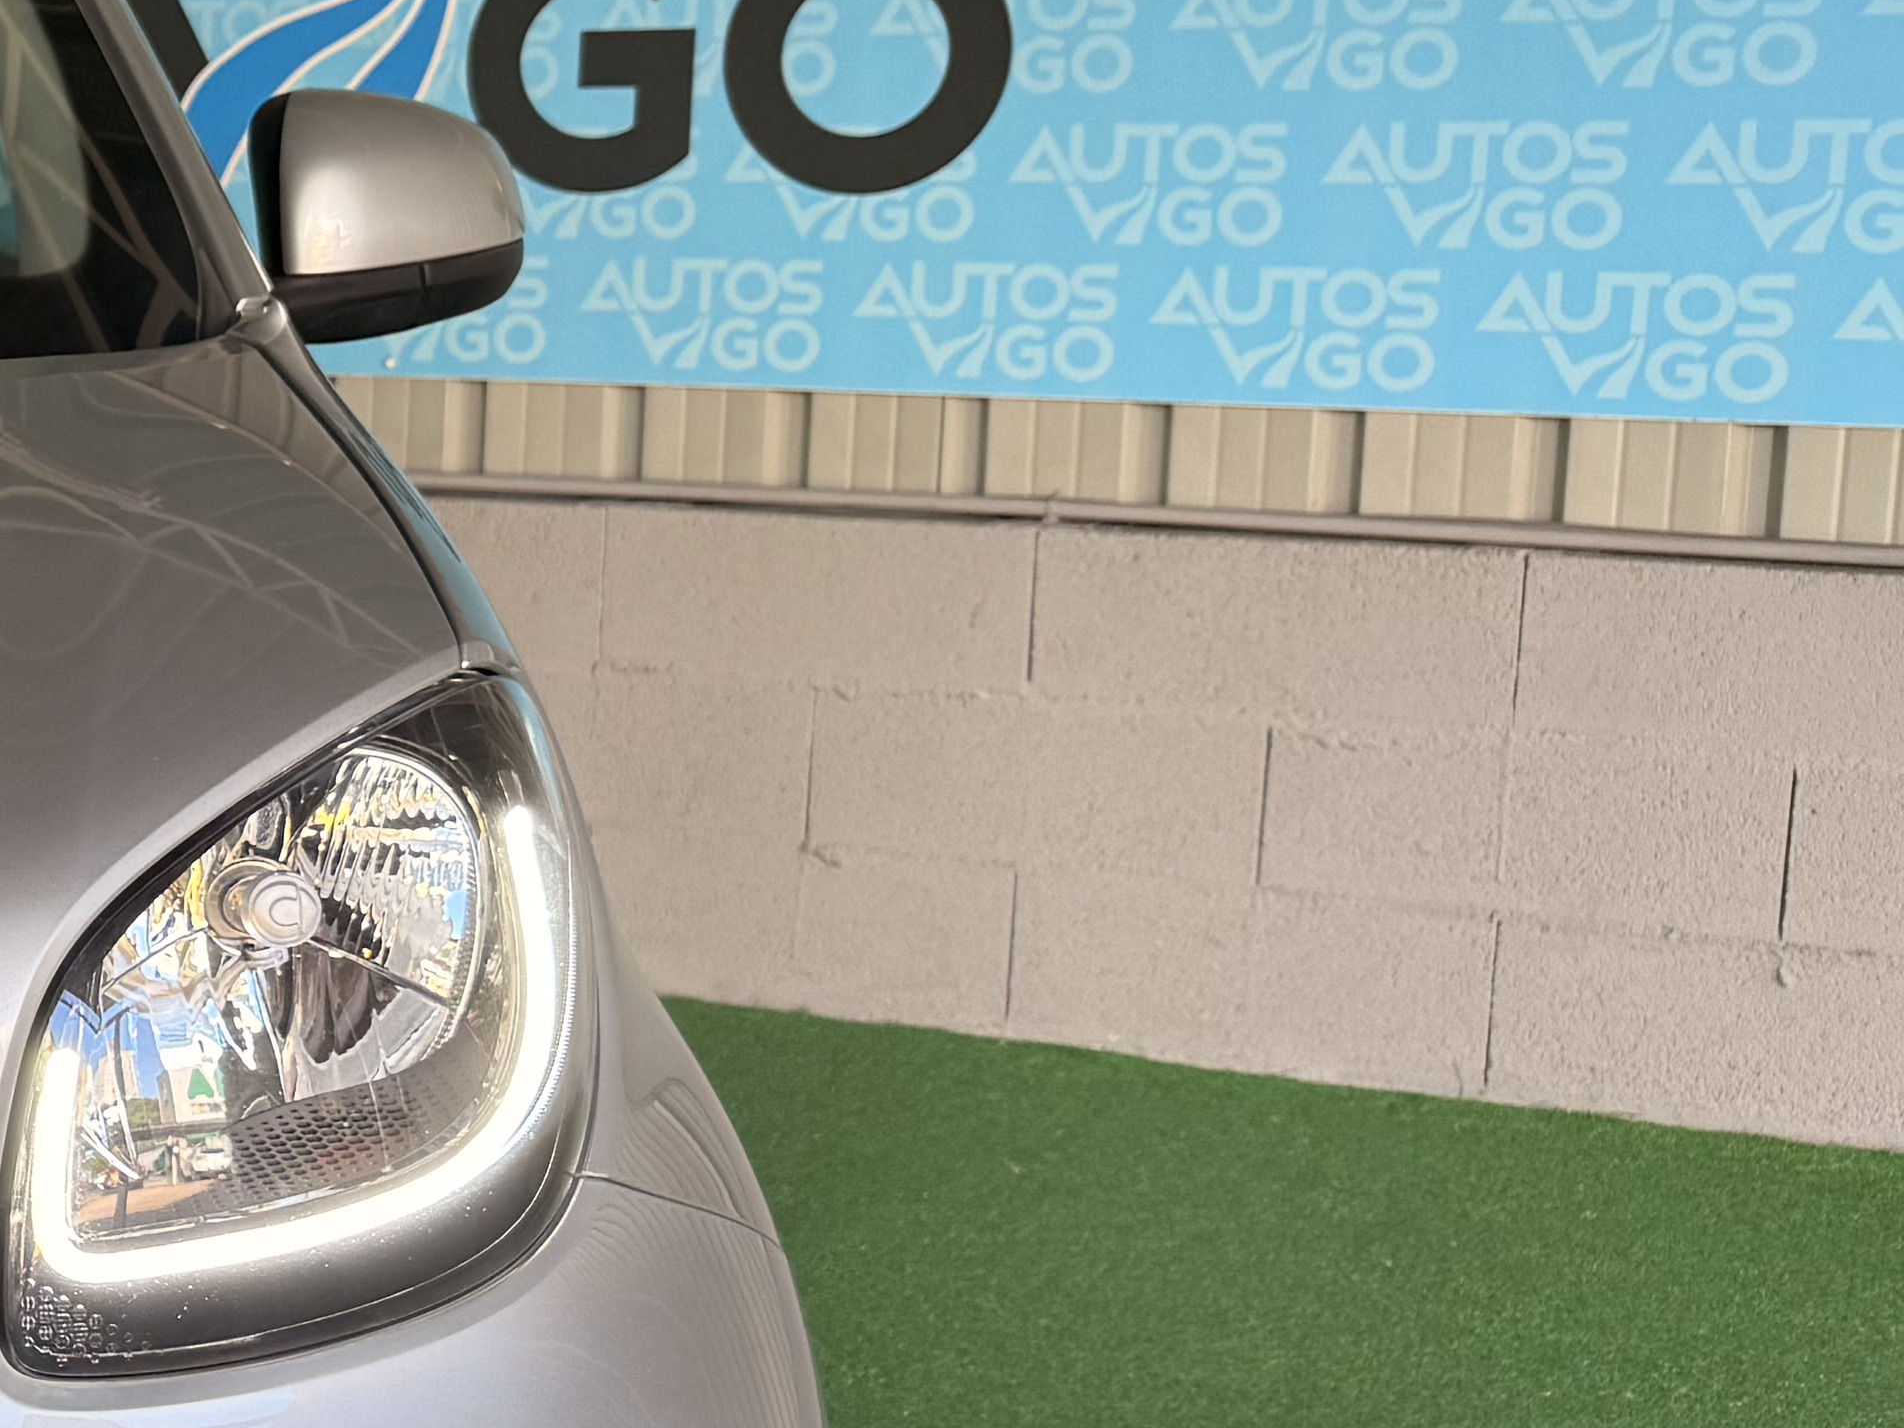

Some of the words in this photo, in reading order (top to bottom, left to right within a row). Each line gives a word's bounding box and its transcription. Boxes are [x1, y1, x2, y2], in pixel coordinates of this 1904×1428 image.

[1232, 27, 1459, 92] VIGO
[1566, 20, 1819, 90] VIGO
[1008, 120, 1288, 184] AUTOS
[1320, 119, 1630, 185] AUTOS
[1064, 184, 1284, 248] VIGO
[1385, 185, 1625, 251] VIGO
[580, 257, 824, 316] AUTOS
[852, 260, 1119, 324] AUTOS
[1149, 266, 1441, 330] AUTOS
[1474, 270, 1797, 339] AUTOS
[629, 315, 822, 372] VIGO
[907, 323, 1115, 383] VIGO
[1209, 327, 1436, 393] VIGO
[1541, 334, 1790, 405] VIGO
